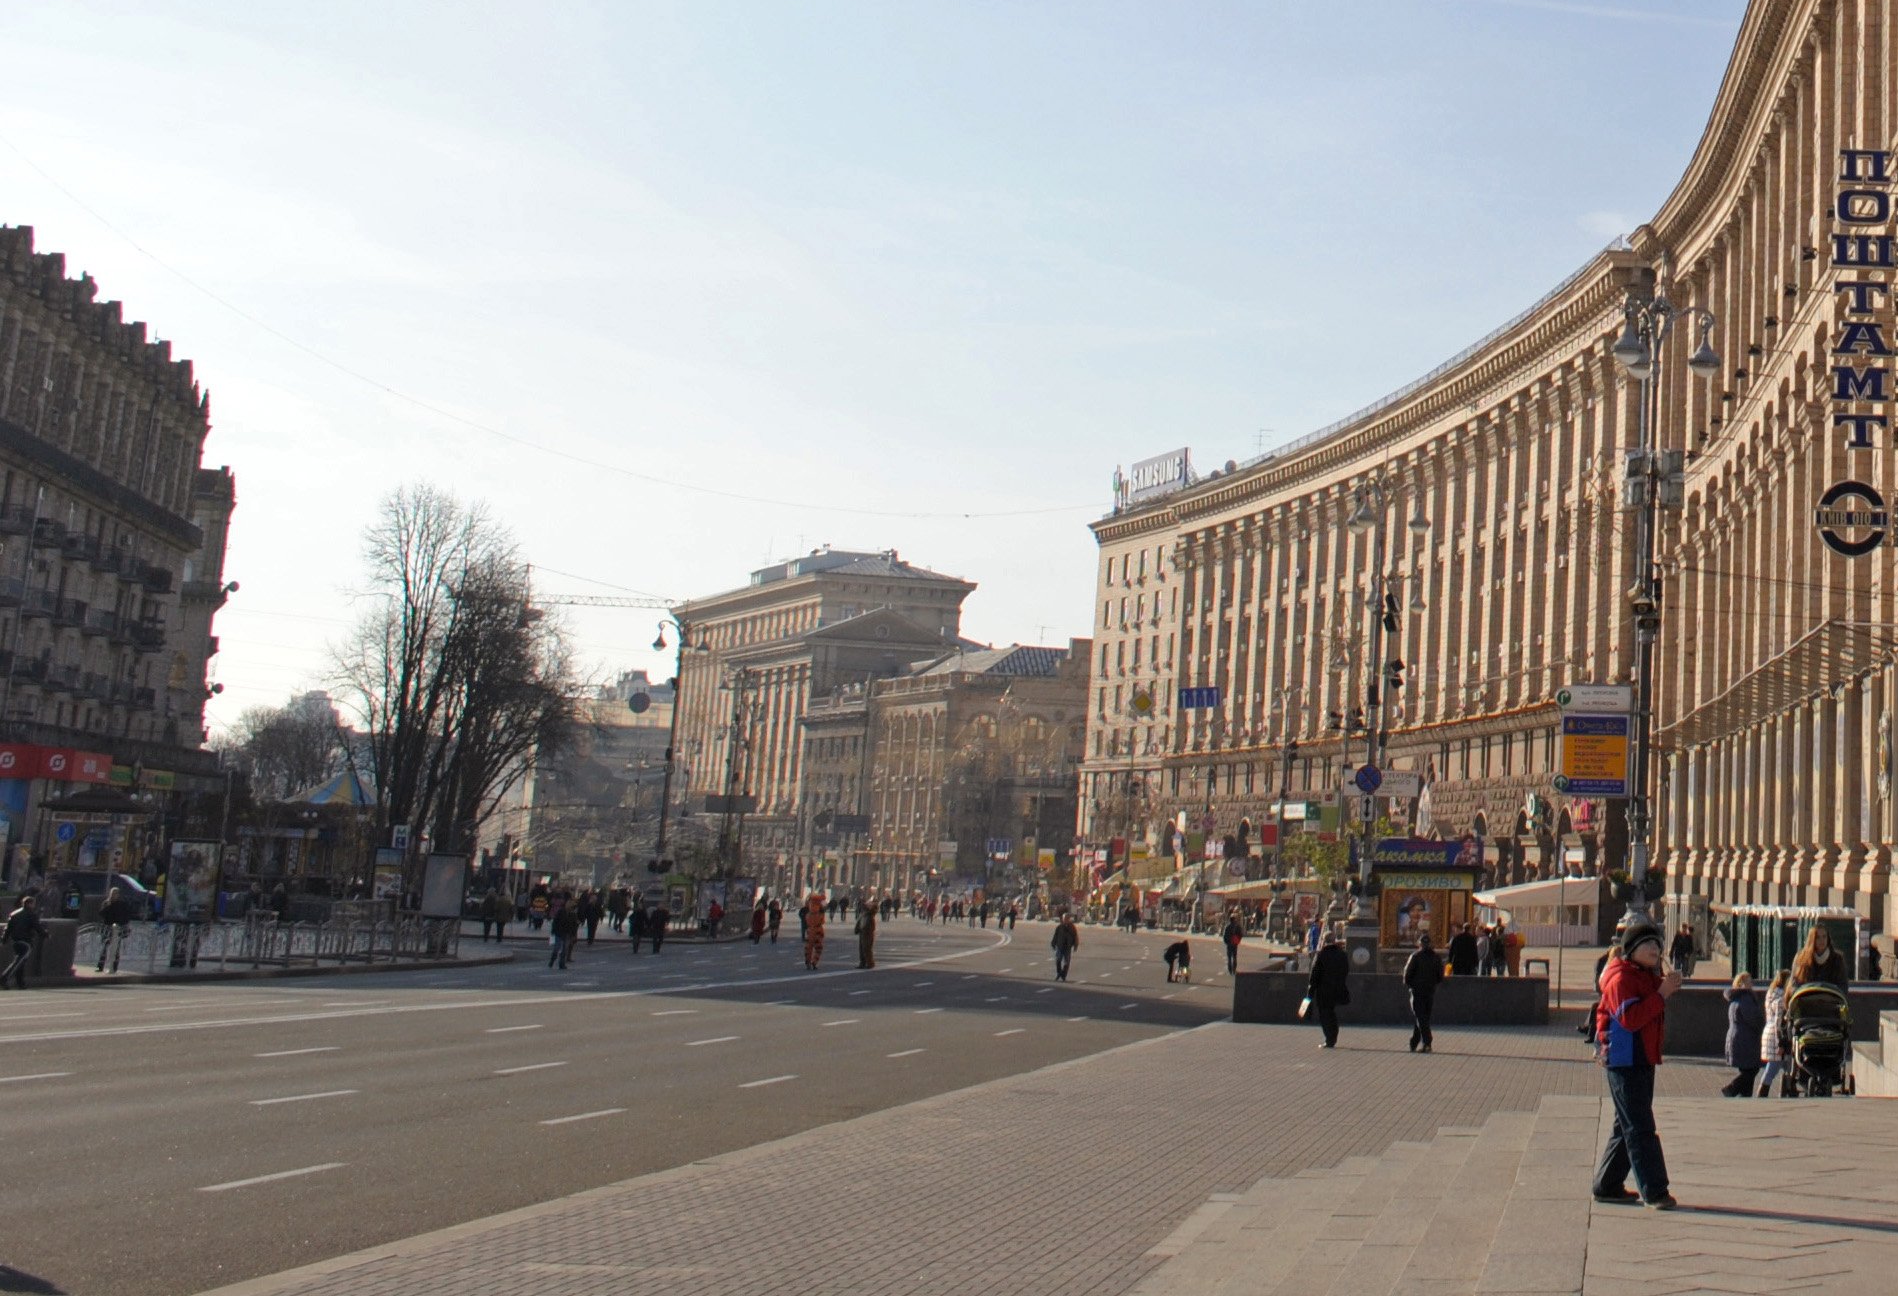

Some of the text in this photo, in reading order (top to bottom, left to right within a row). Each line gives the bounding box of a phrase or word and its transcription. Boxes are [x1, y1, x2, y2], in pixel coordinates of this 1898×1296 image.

[1831, 149, 1897, 449] ПОШТАМТ
[1132, 456, 1184, 492] SAMSUNG
[1374, 851, 1447, 862] акомка
[1382, 875, 1461, 888] ОРОЗИВО
